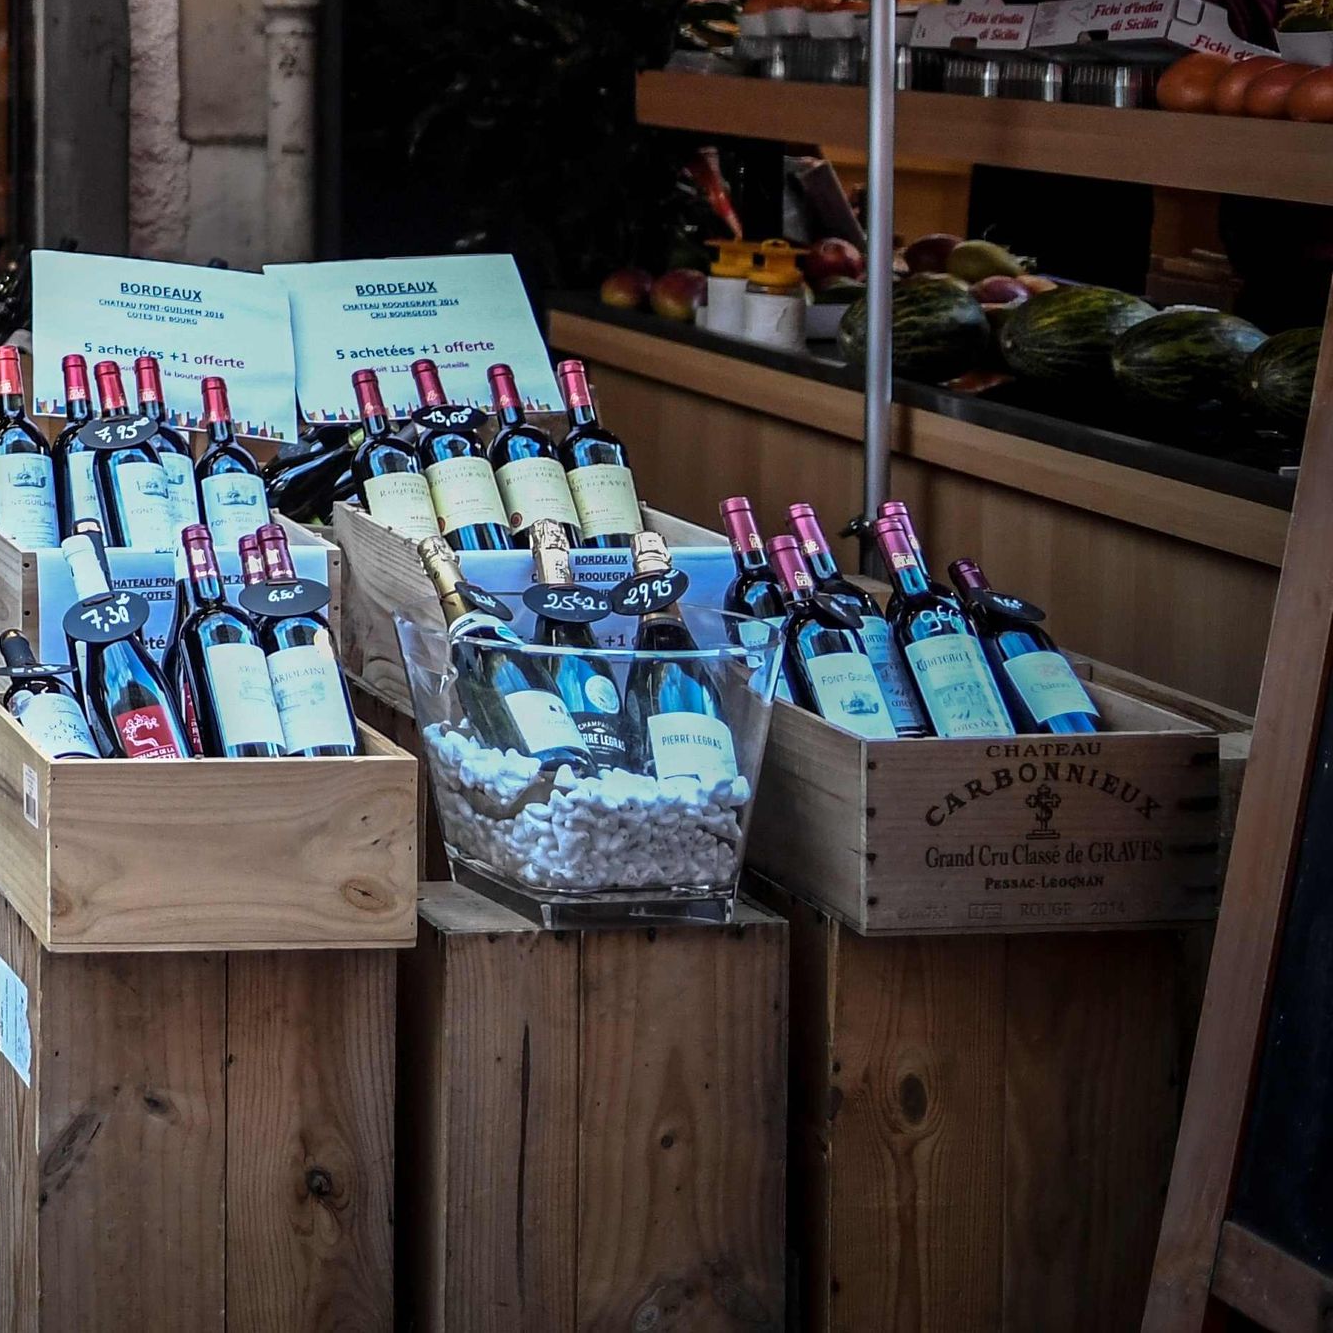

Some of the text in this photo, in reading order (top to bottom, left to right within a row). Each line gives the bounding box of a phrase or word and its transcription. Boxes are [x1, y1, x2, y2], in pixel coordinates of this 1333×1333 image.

[1094, 3, 1121, 19] Fichi
[1110, 16, 1160, 33] di Sicilia
[1190, 33, 1231, 57] Fichi
[120, 281, 203, 302] BORDEAUX
[355, 281, 438, 298] BORDEAUX
[98, 298, 137, 310] CHATEAU
[342, 300, 380, 312] CHATEAU
[84, 342, 93, 353] 5
[98, 344, 164, 361] achetées
[194, 354, 246, 370] offerte
[336, 349, 346, 361] 5
[349, 344, 415, 360] achetées
[444, 339, 496, 354] offerte
[574, 554, 629, 566] BORDEAUX
[110, 577, 154, 589] HATEAU
[578, 570, 634, 583] ROQUEGRA
[661, 734, 723, 750] PIERRE LEGRAS
[985, 741, 1103, 759] CHATEAU
[924, 761, 1163, 828] CARBONNIEUX
[925, 840, 1164, 868] Grand Cru Classé de GRAVES
[1020, 902, 1073, 917] ROUGE
